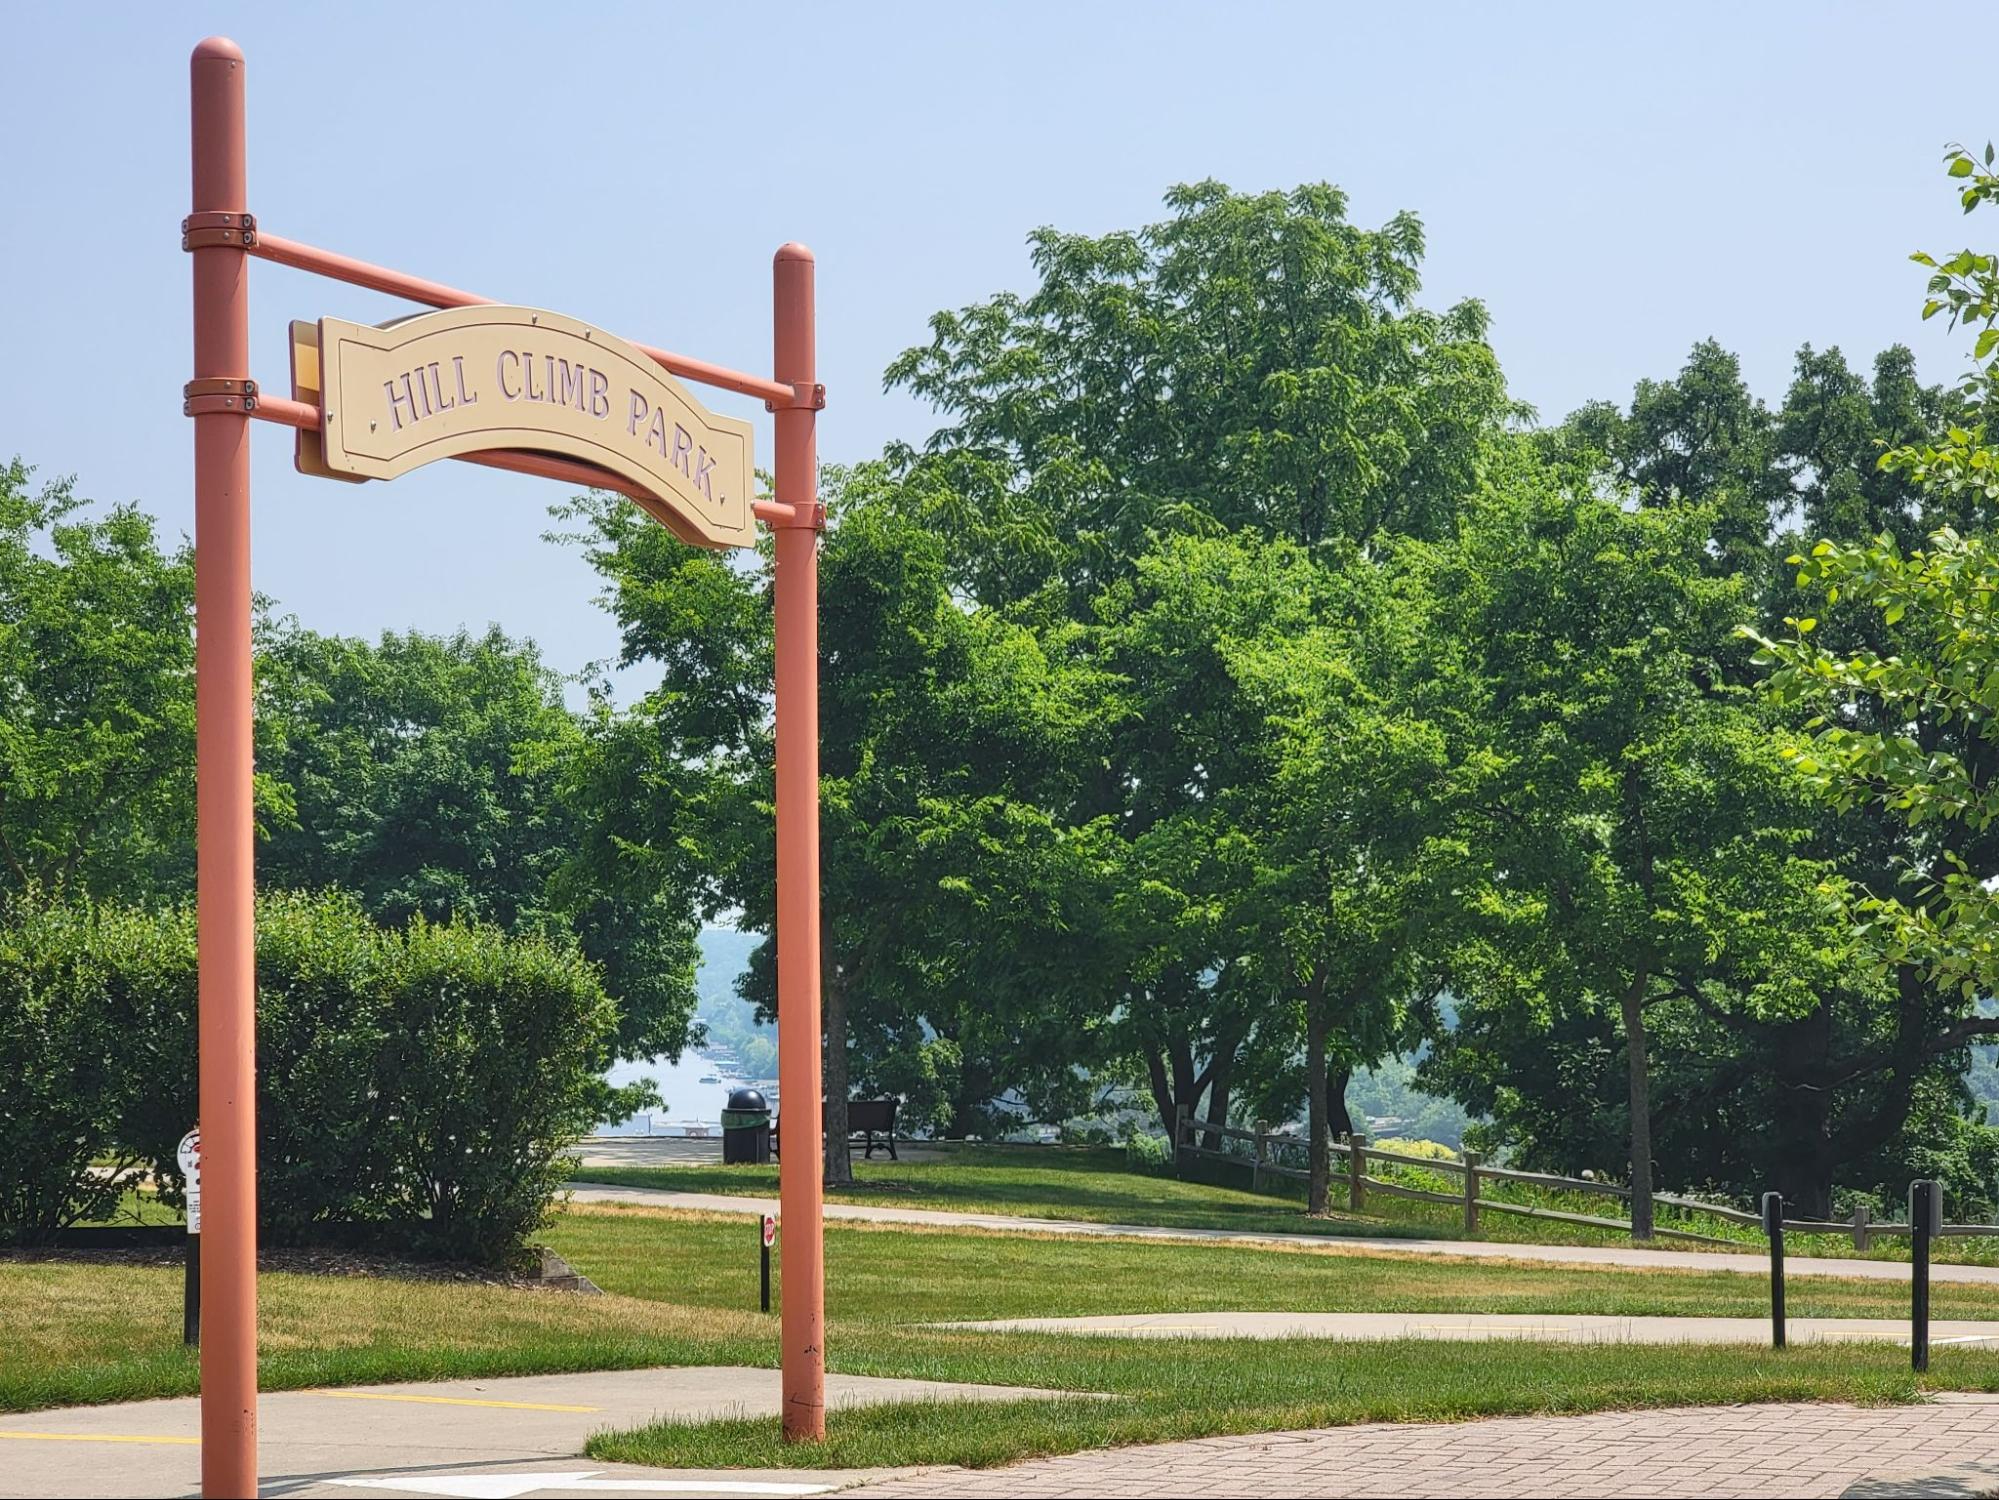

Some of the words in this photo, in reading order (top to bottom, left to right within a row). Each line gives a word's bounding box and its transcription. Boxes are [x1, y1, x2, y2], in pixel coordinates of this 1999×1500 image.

[383, 355, 477, 432] HILL
[496, 349, 609, 420] CLIMB
[626, 388, 716, 502] PARK
